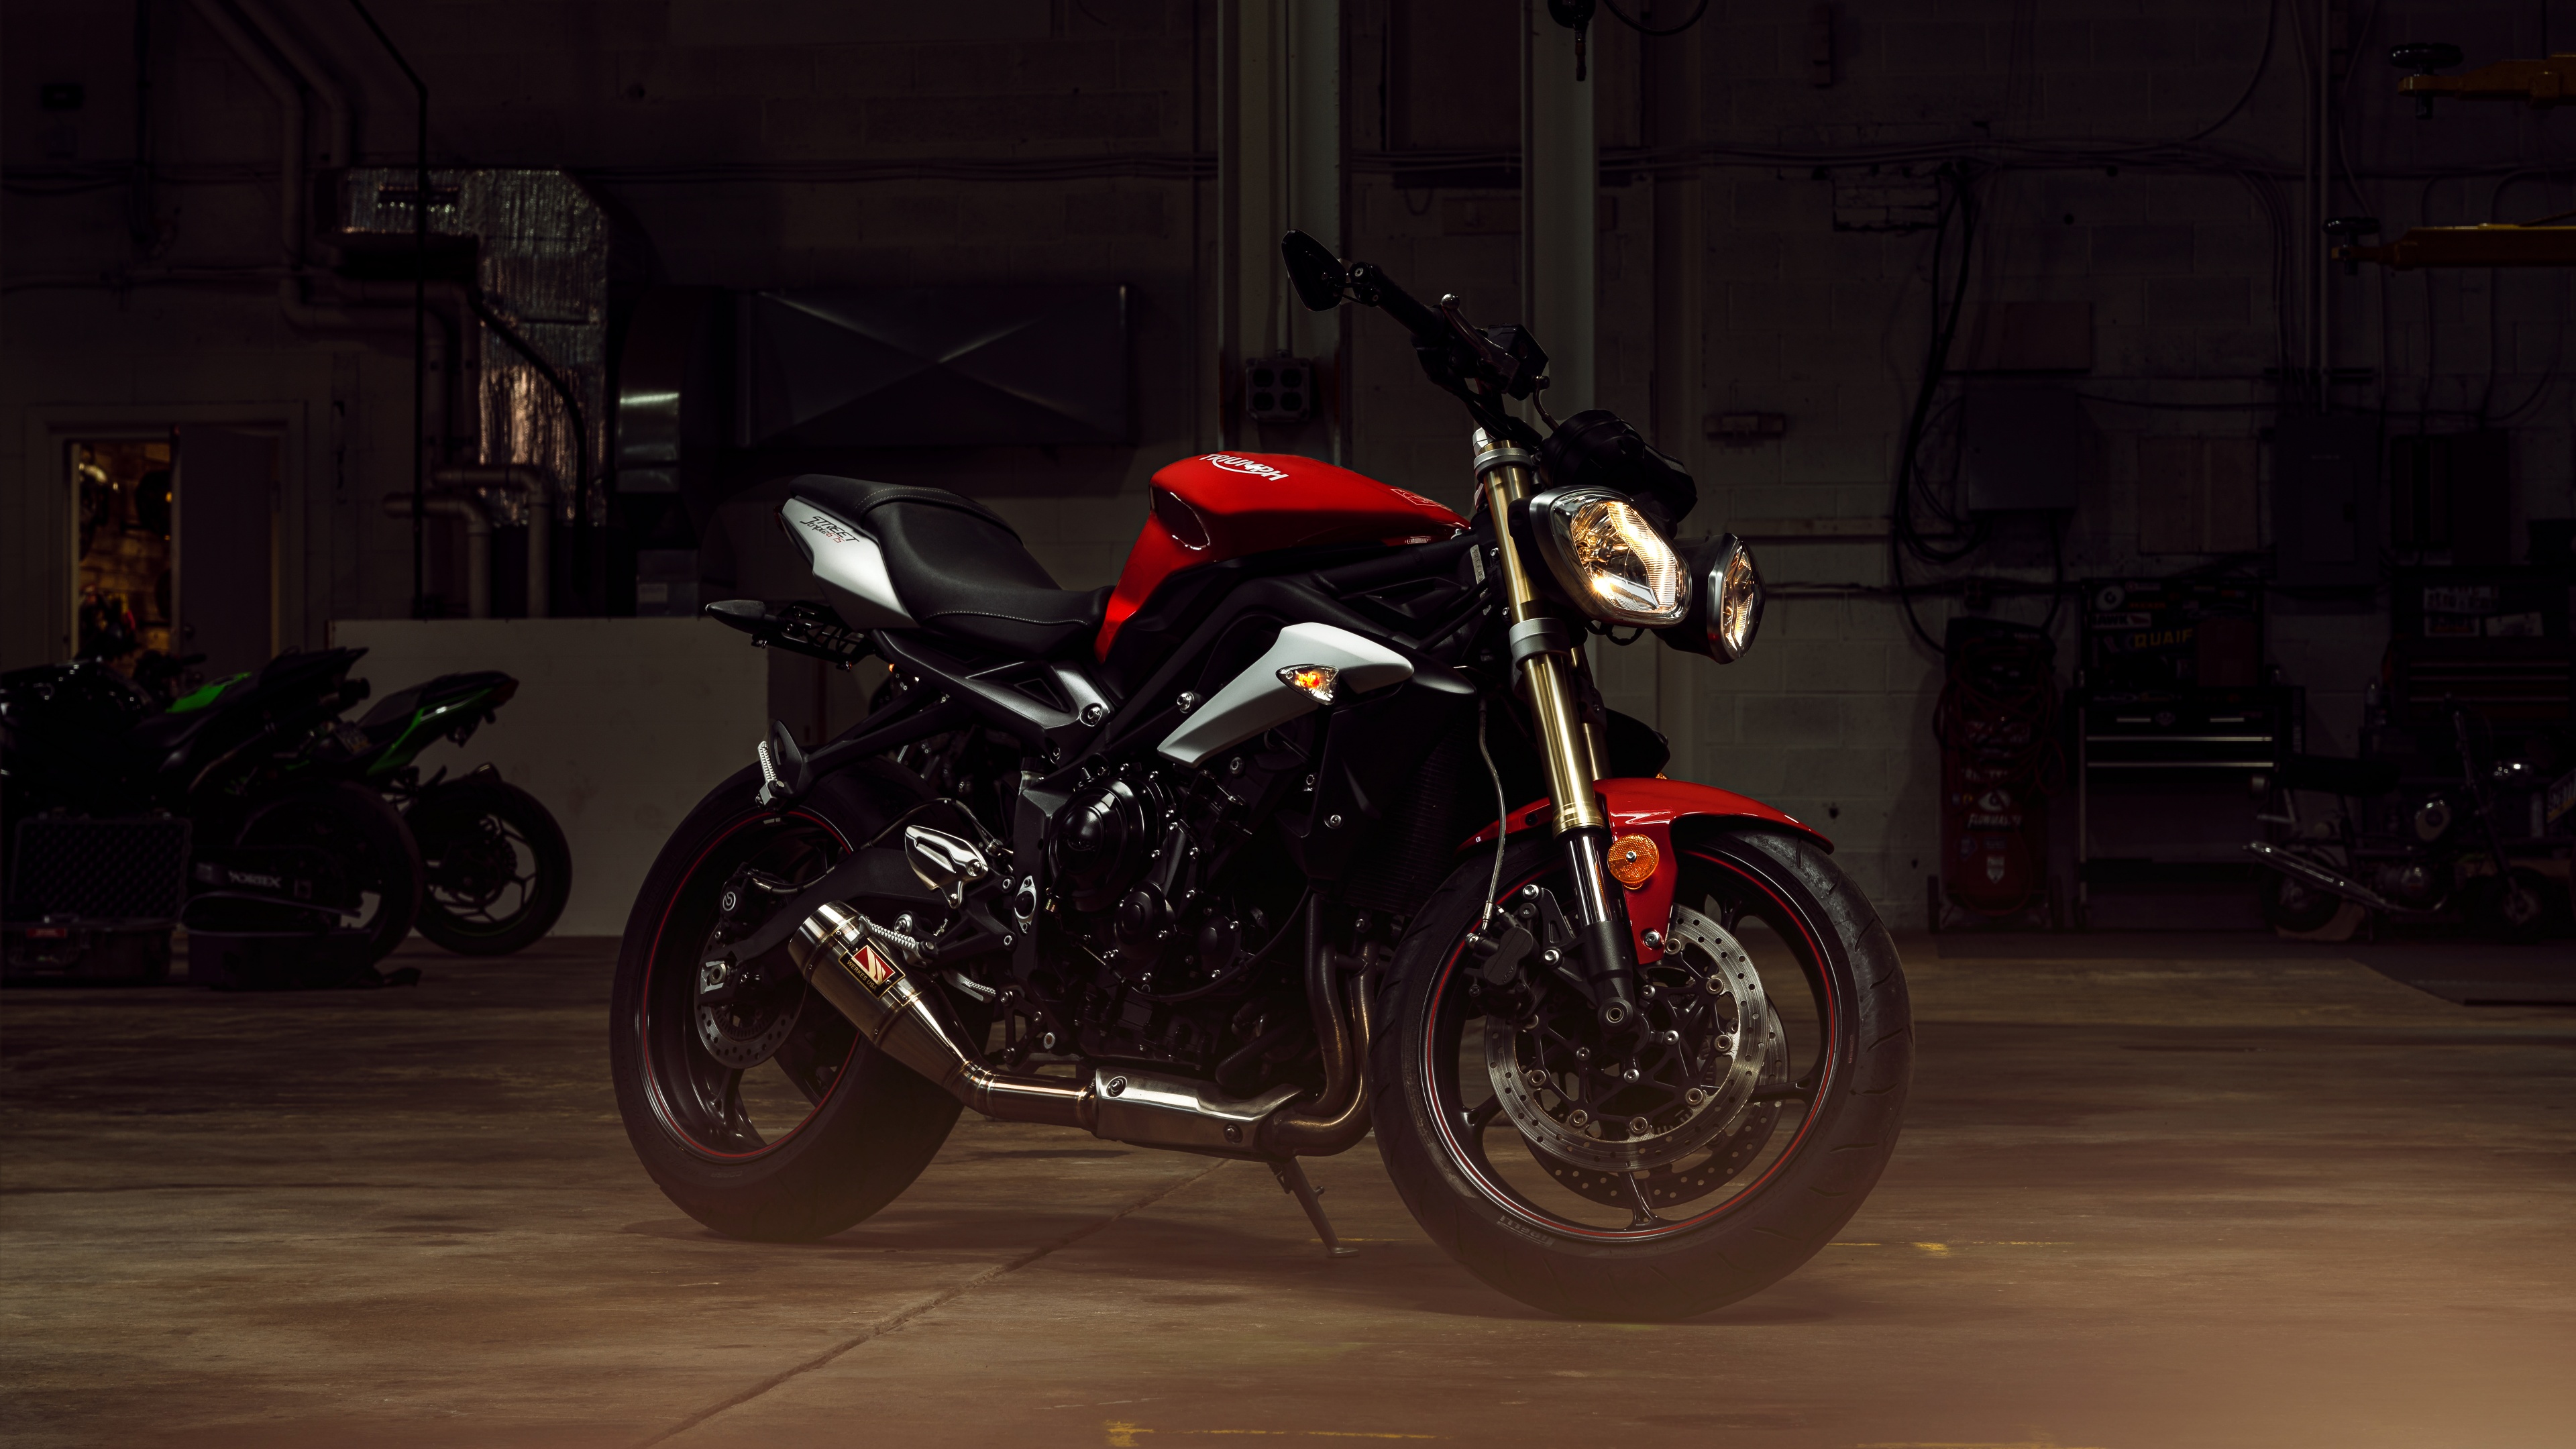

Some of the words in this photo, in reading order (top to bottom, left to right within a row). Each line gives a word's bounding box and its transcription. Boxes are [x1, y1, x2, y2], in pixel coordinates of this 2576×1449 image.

[1198, 453, 1289, 482] TRIUMPH
[800, 516, 860, 542] STREET
[826, 532, 845, 543] 675
[2133, 627, 2194, 649] QUAIF
[227, 869, 283, 890] VORTEX
[847, 959, 868, 982] WERKES
[866, 978, 878, 991] USA
[1496, 1215, 1556, 1248] PIRELLI
